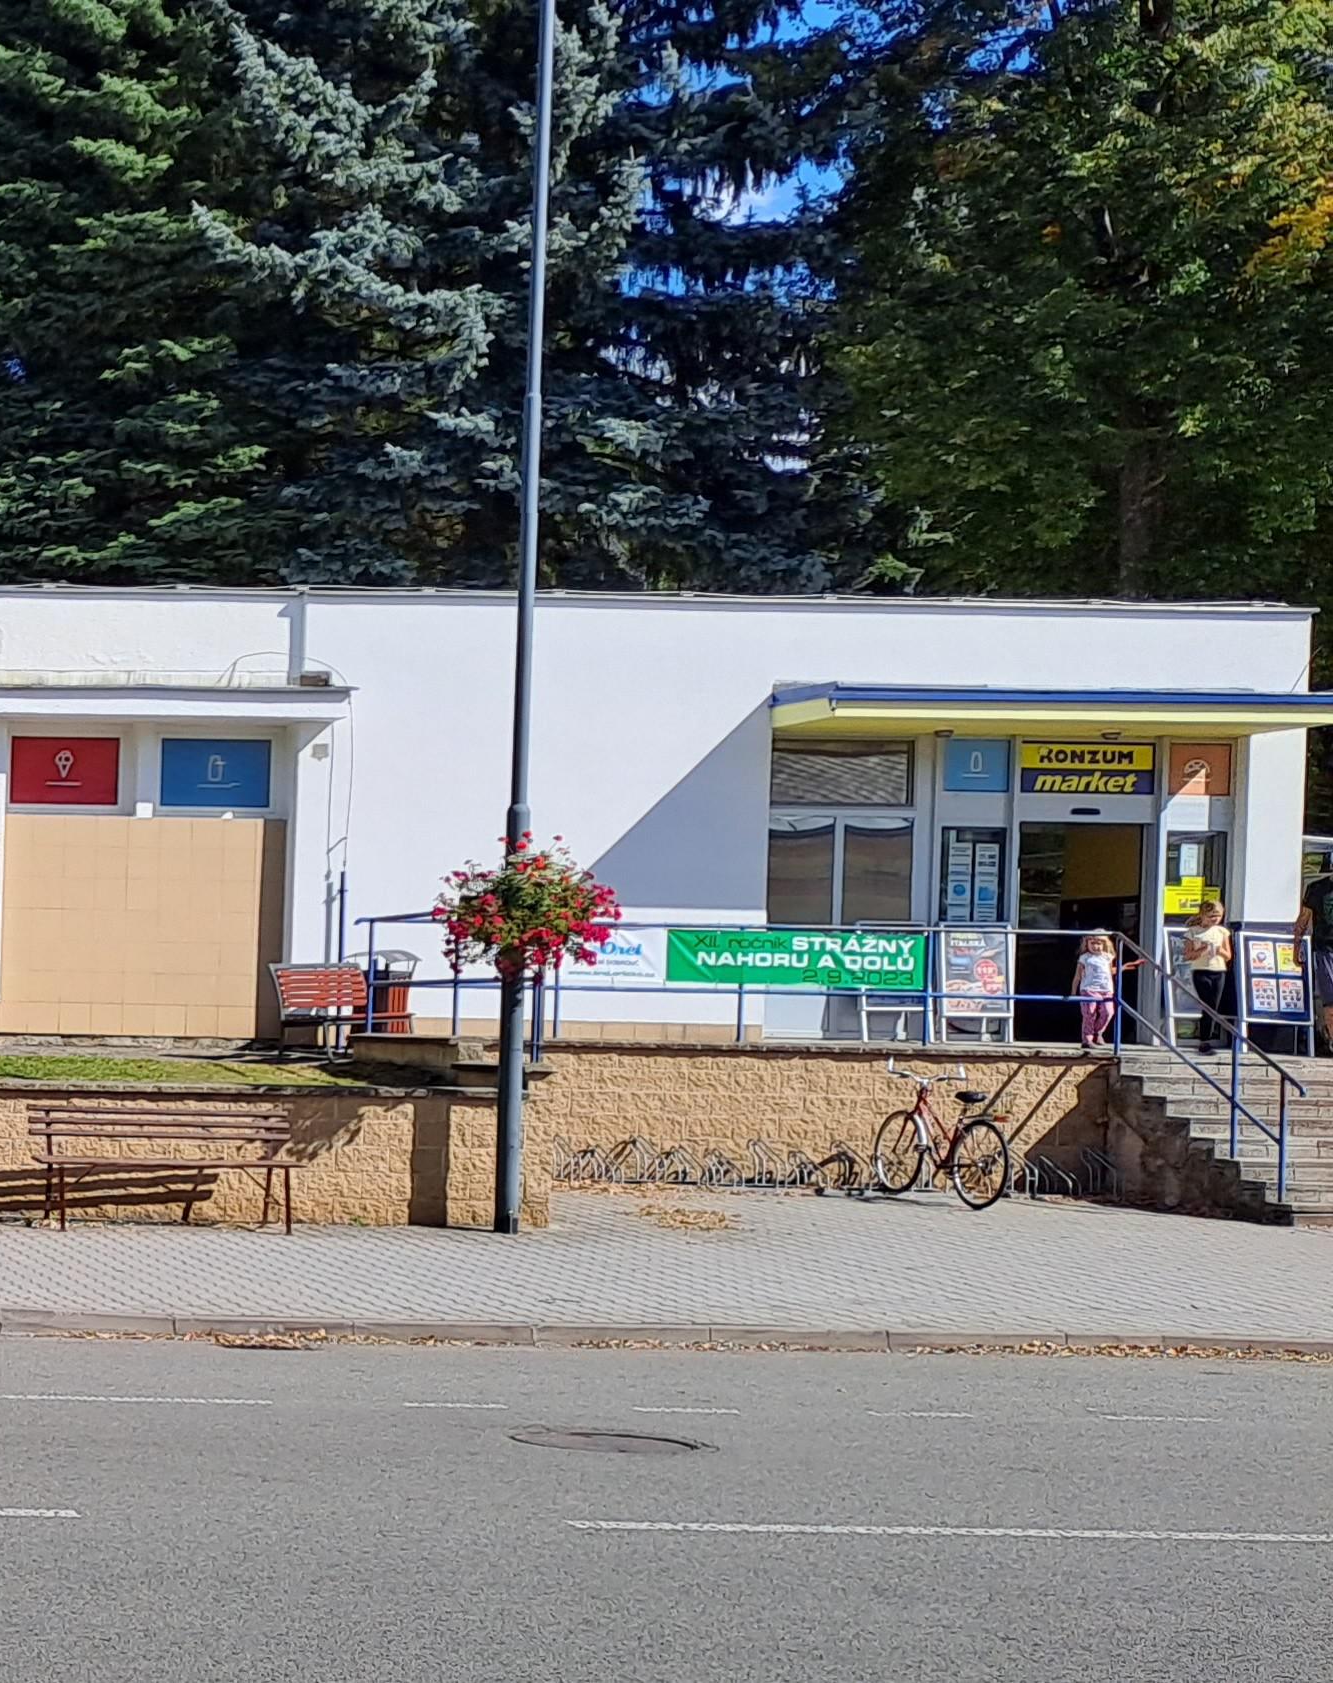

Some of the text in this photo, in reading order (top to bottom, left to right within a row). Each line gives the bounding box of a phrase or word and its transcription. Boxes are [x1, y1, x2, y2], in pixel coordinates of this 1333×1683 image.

[1038, 748, 1134, 765] KONZUM
[1033, 771, 1137, 793] market
[728, 935, 787, 950] ročník
[791, 934, 915, 954] STRÁŽNÝ
[696, 951, 915, 971] NAHORU A DOLŮ
[802, 969, 915, 986] 2.9.2023
